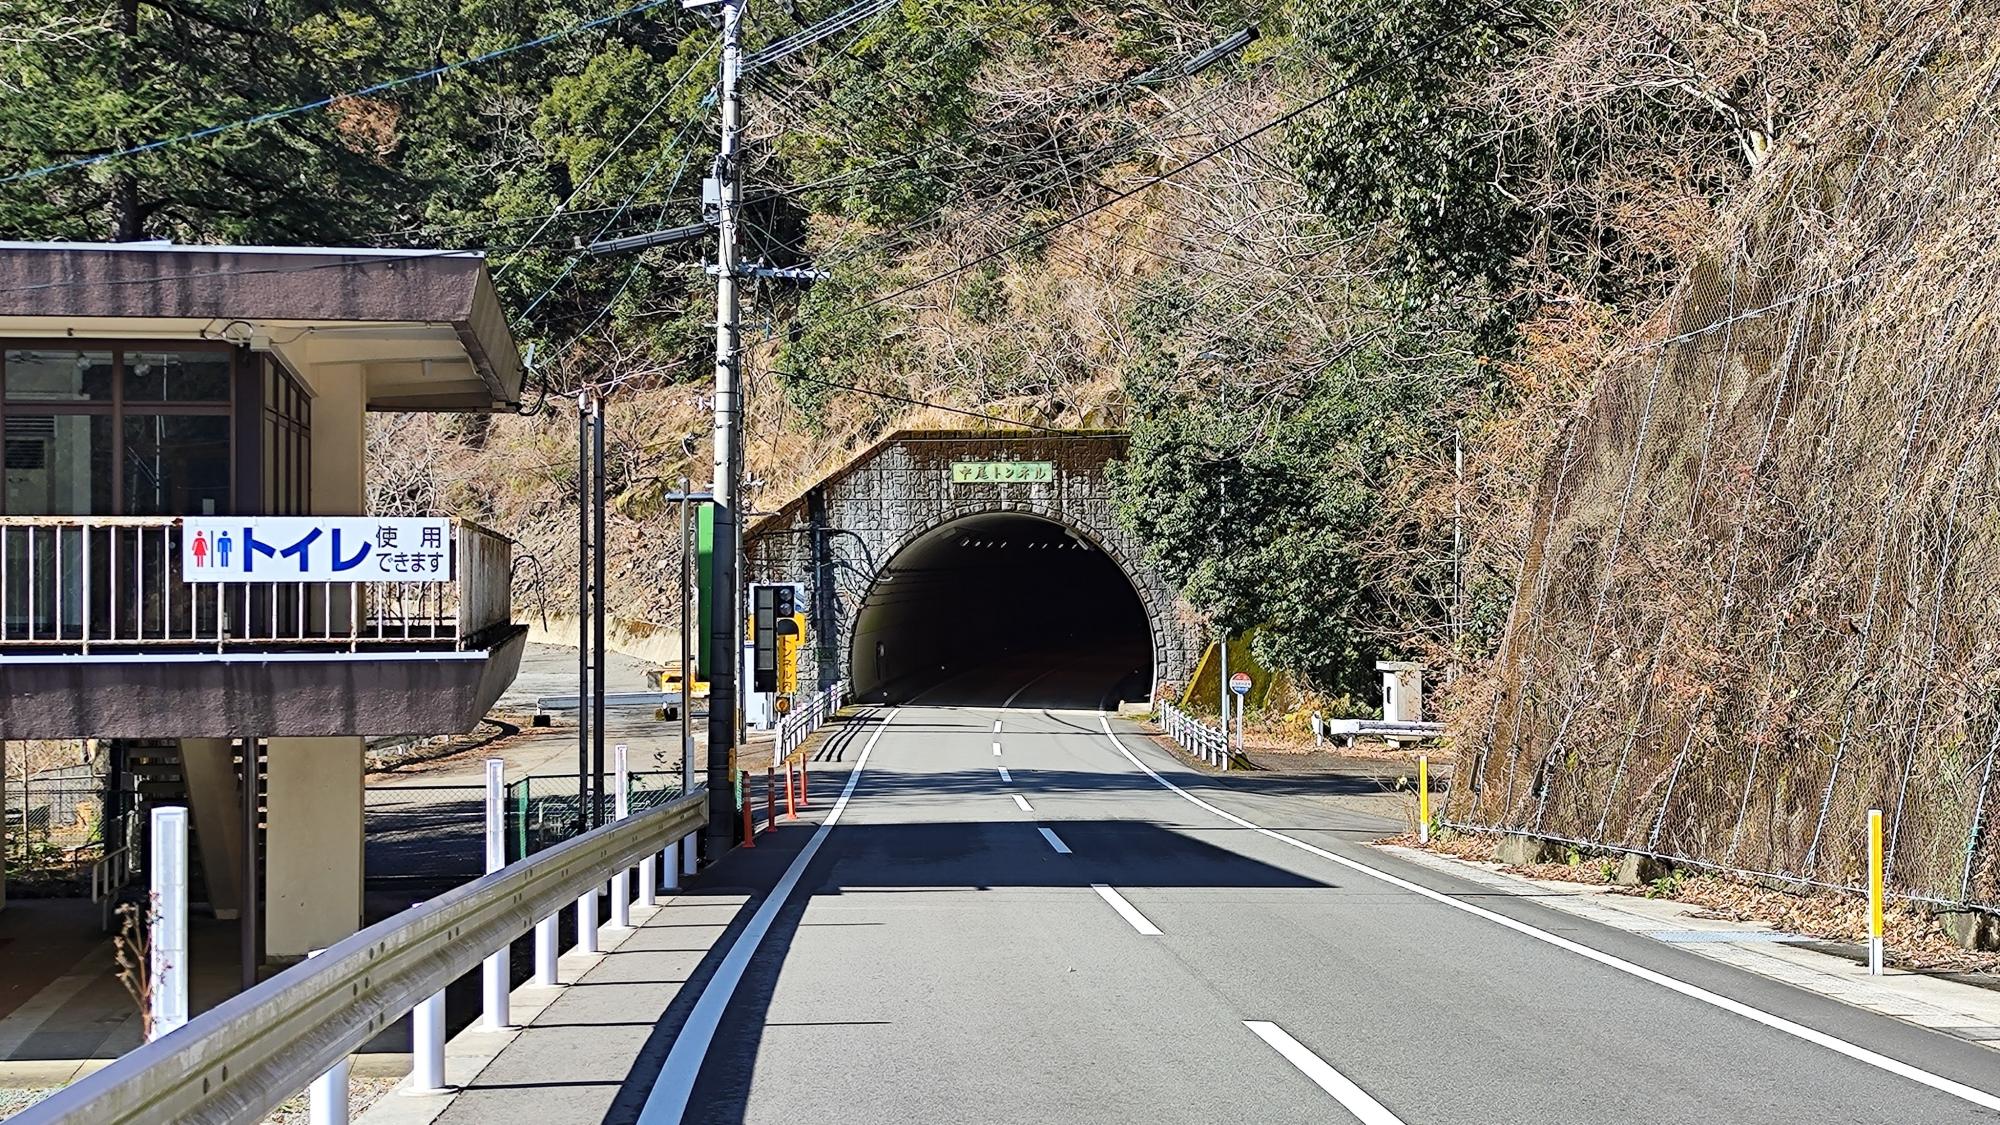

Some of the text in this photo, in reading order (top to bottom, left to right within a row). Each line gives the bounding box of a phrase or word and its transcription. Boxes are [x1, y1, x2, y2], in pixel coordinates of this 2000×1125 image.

[243, 527, 372, 572] トイレ
[376, 552, 444, 572] できます
